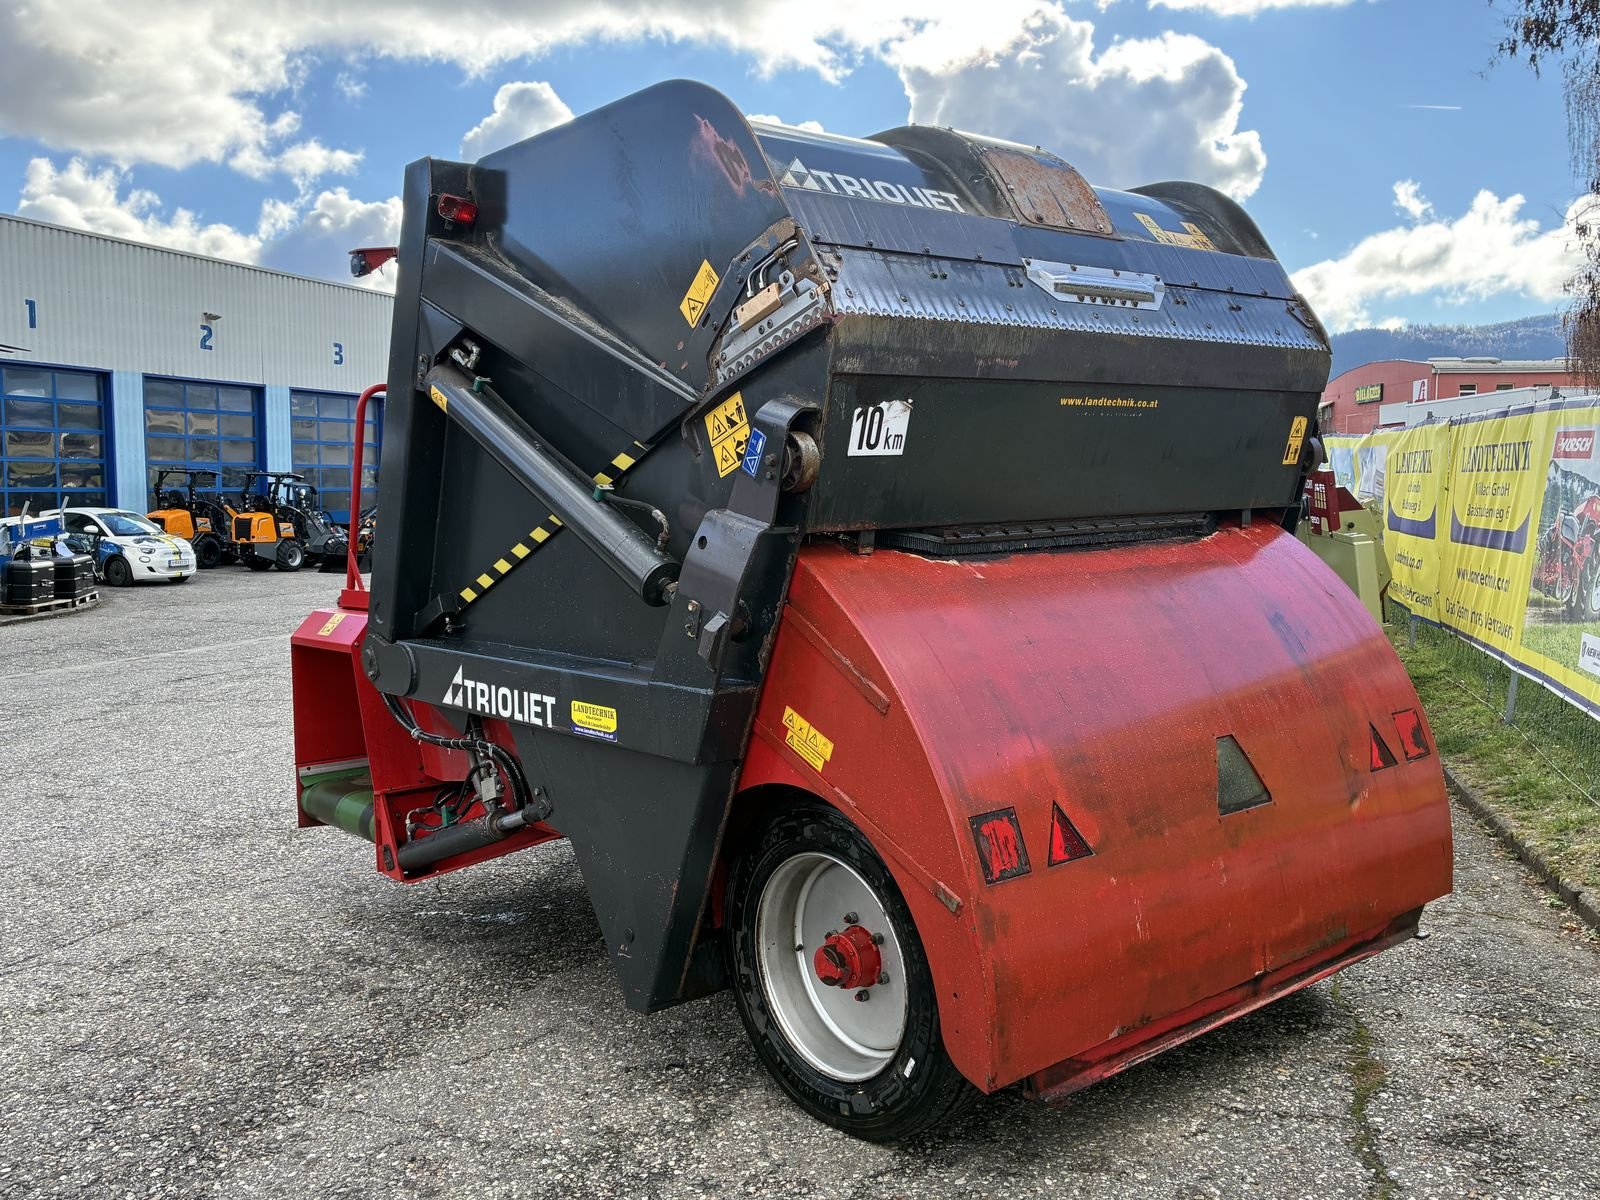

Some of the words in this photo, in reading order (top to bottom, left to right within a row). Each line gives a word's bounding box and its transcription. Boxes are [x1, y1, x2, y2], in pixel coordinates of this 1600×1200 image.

[809, 167, 966, 214] TRIOLIET
[24, 298, 37, 329] 1
[199, 324, 213, 351] 2
[332, 342, 344, 365] 3
[1060, 396, 1159, 409] www.landtechnik.co.at
[855, 405, 885, 451] 10
[883, 427, 904, 451] km
[463, 678, 556, 728] TRIOLIET
[573, 702, 616, 720] LANDTECHNIK
